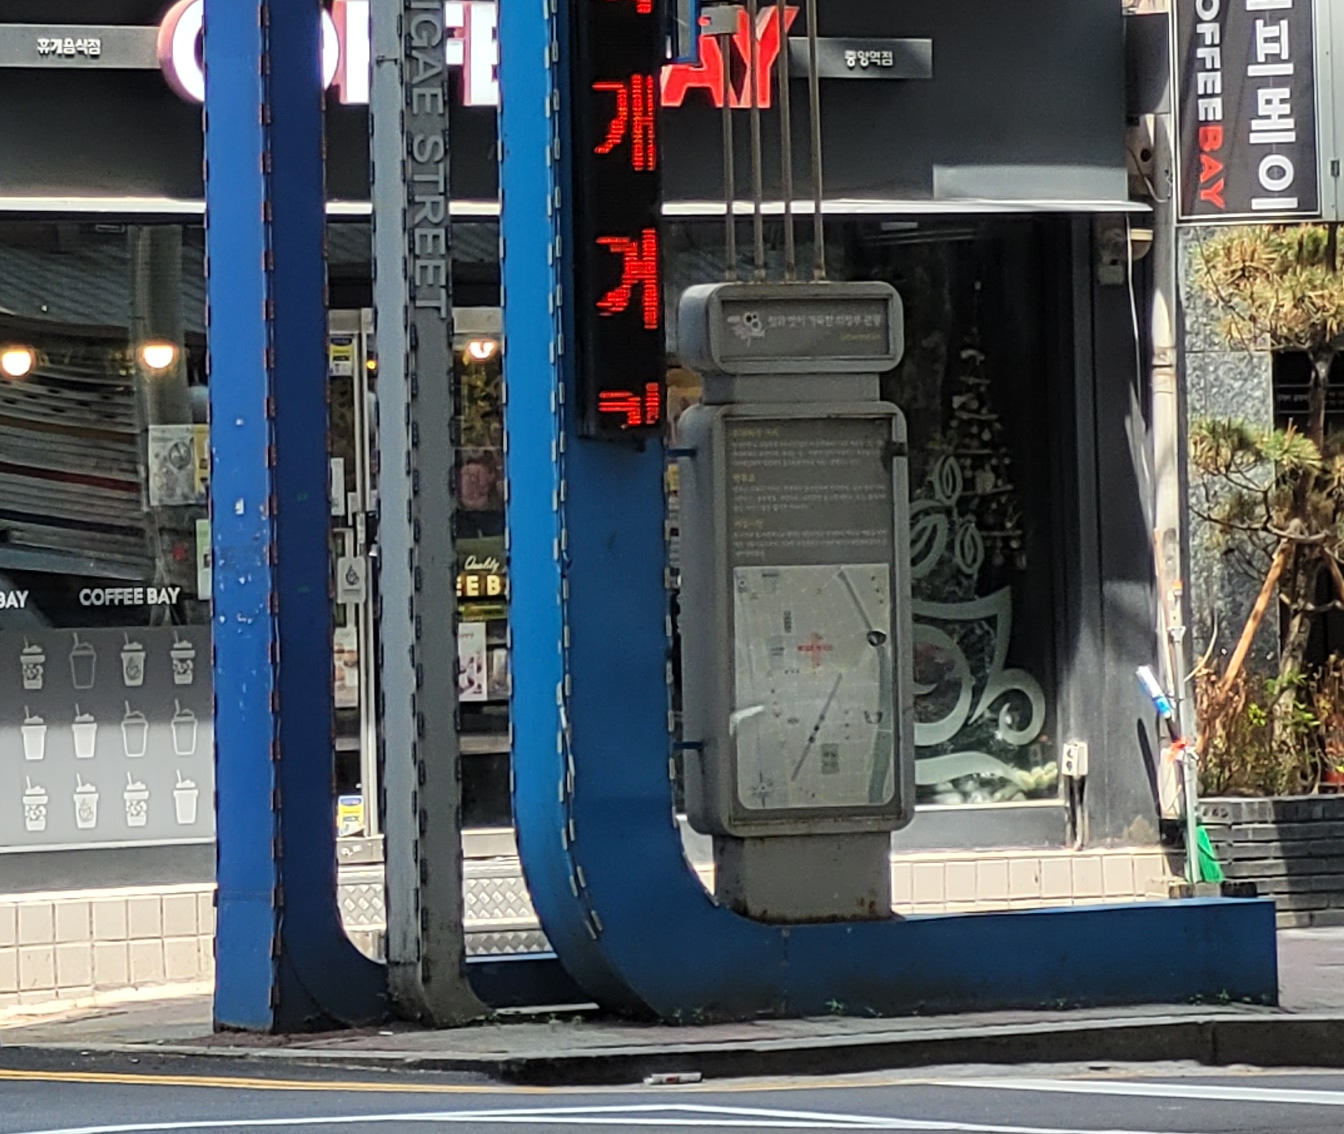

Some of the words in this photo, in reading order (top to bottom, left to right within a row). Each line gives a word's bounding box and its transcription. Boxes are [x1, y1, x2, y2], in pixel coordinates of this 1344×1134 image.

[37, 37, 101, 56] 휴게음식점
[844, 49, 894, 67] 중앙역점
[413, 131, 448, 319] STREET
[464, 555, 500, 573] Quality
[79, 588, 144, 606] COFFEE
[146, 587, 181, 605] BAY
